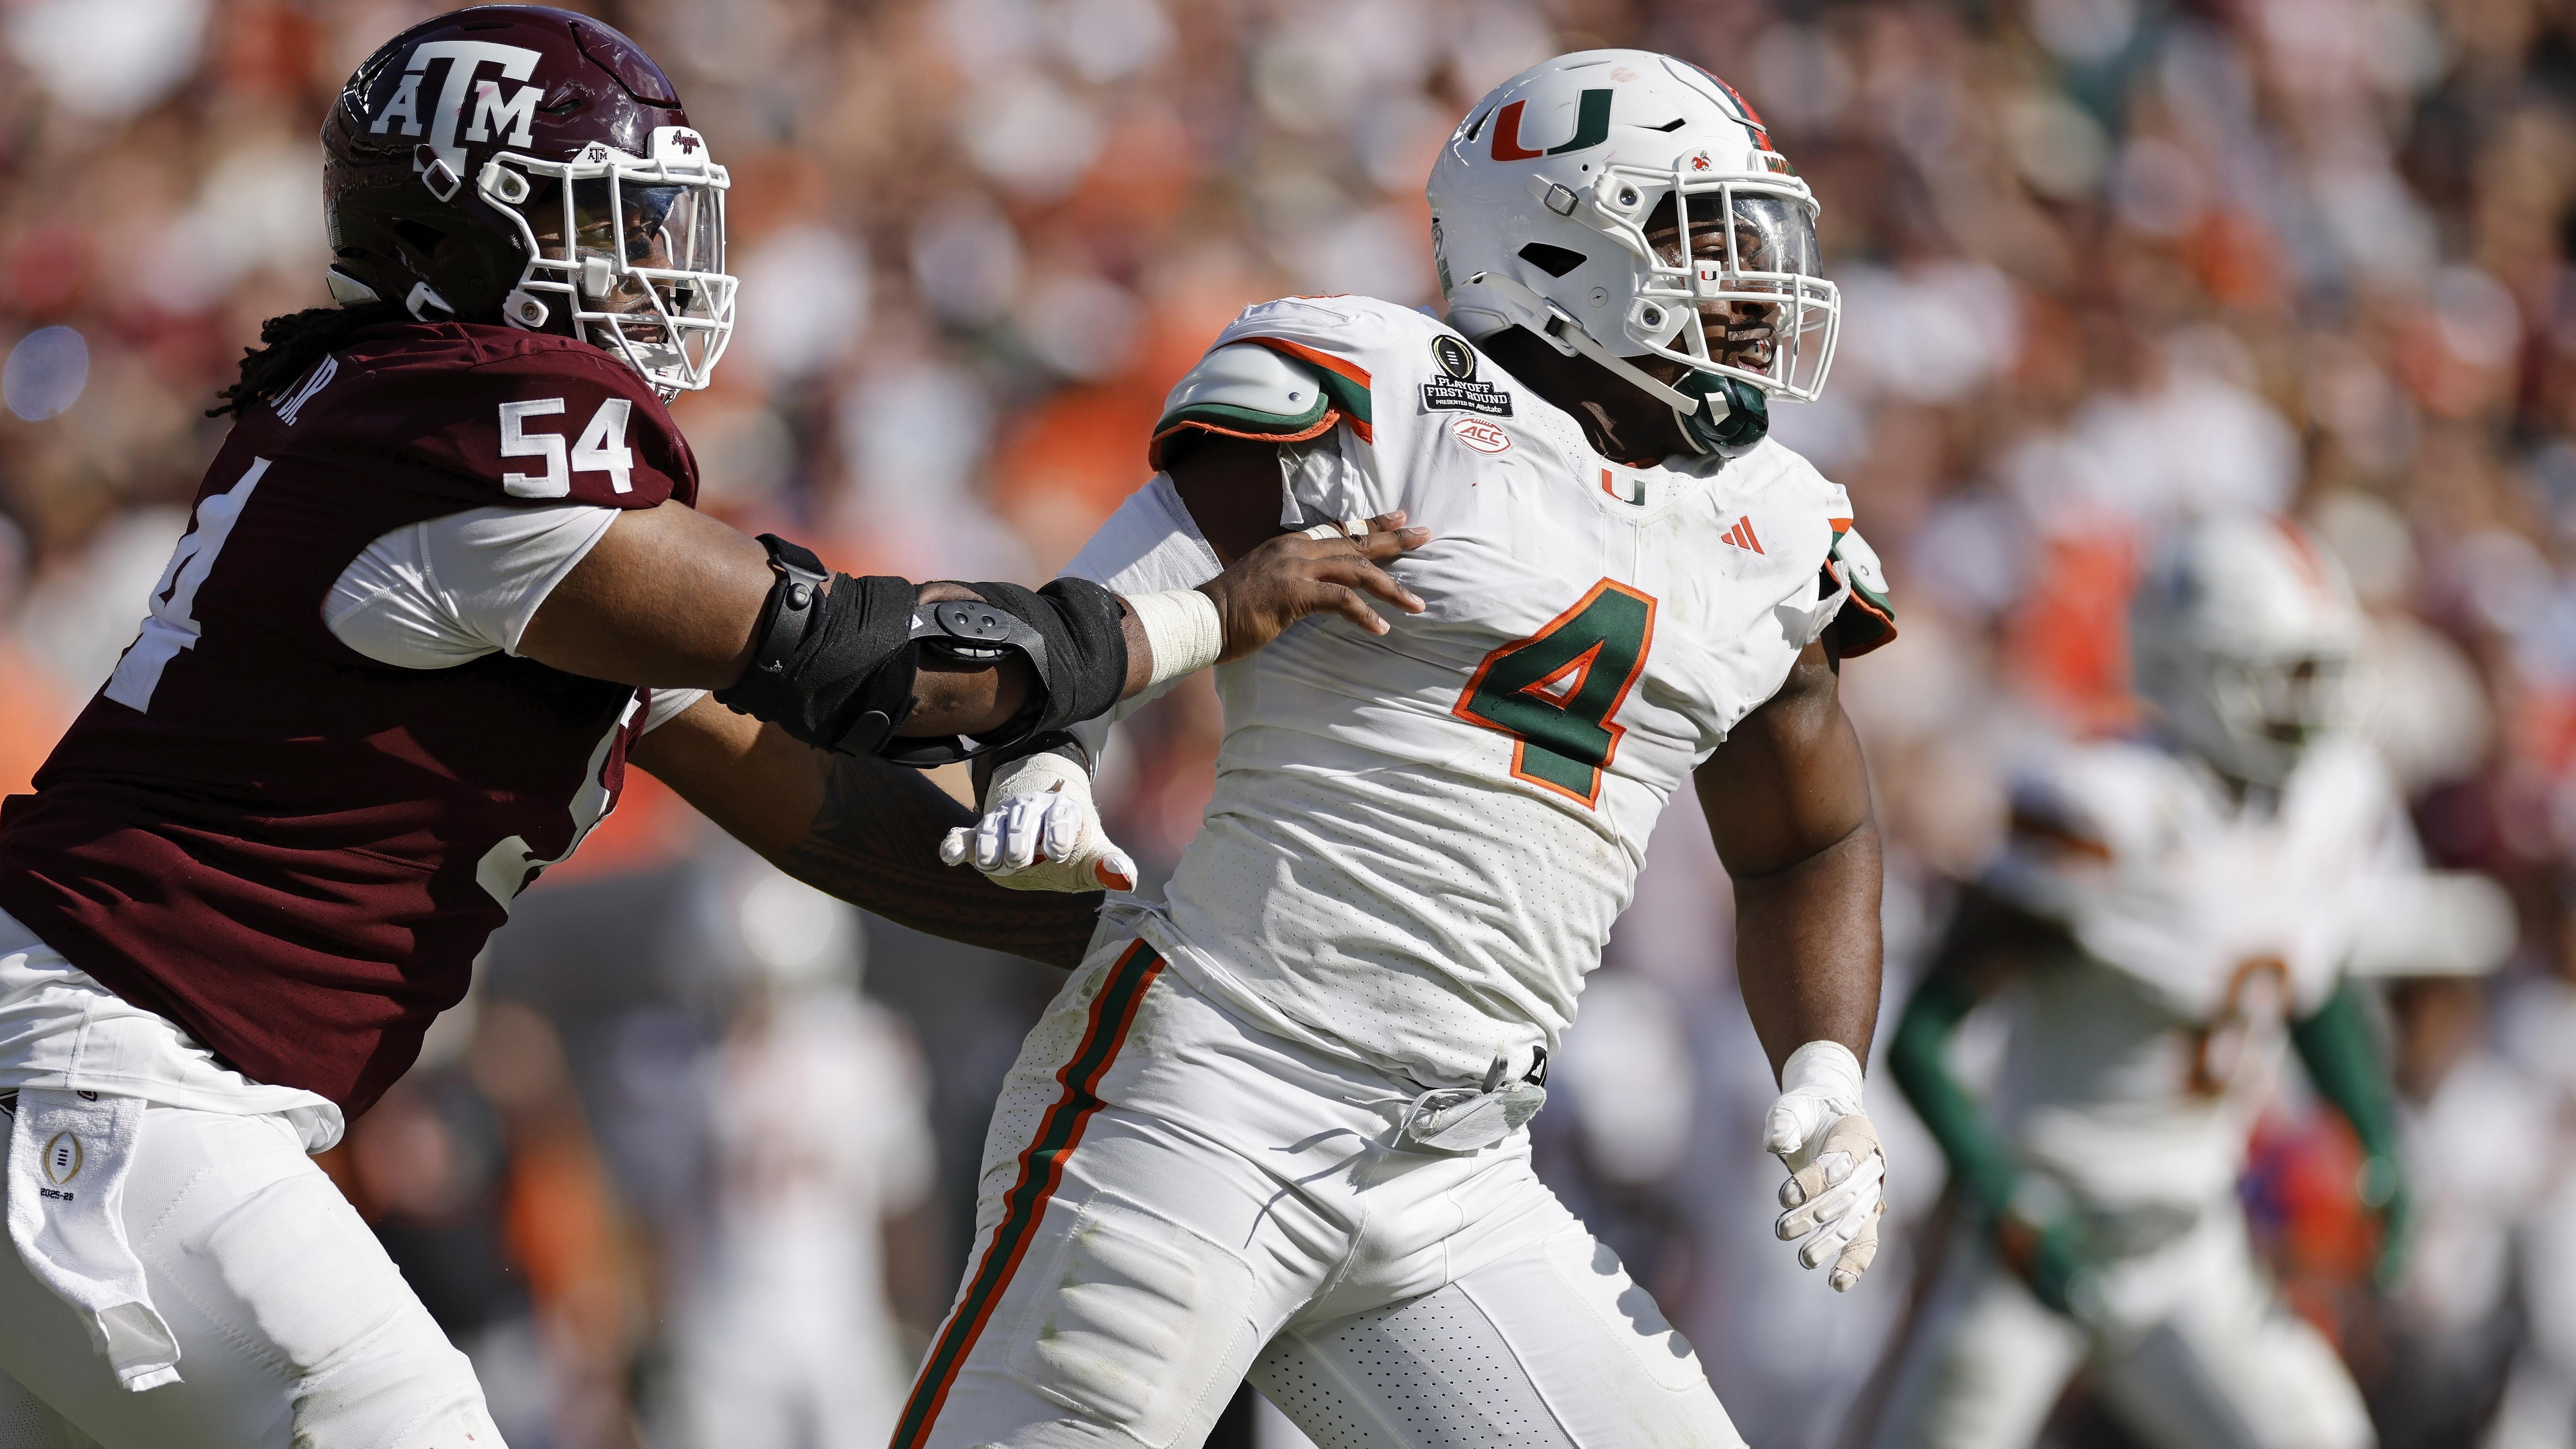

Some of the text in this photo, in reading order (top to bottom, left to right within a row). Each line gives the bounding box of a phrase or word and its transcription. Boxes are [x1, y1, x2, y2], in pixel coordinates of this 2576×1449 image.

[1490, 88, 1614, 161] U
[1701, 271, 1717, 281] U
[1437, 377, 1490, 393] PLAYOFF
[1426, 386, 1508, 404] FIRST ROUND
[1476, 403, 1502, 413] Allstate
[1460, 425, 1504, 444] ACC
[499, 397, 634, 498] 54
[1599, 467, 1648, 509] U
[1451, 577, 1658, 811] 4
